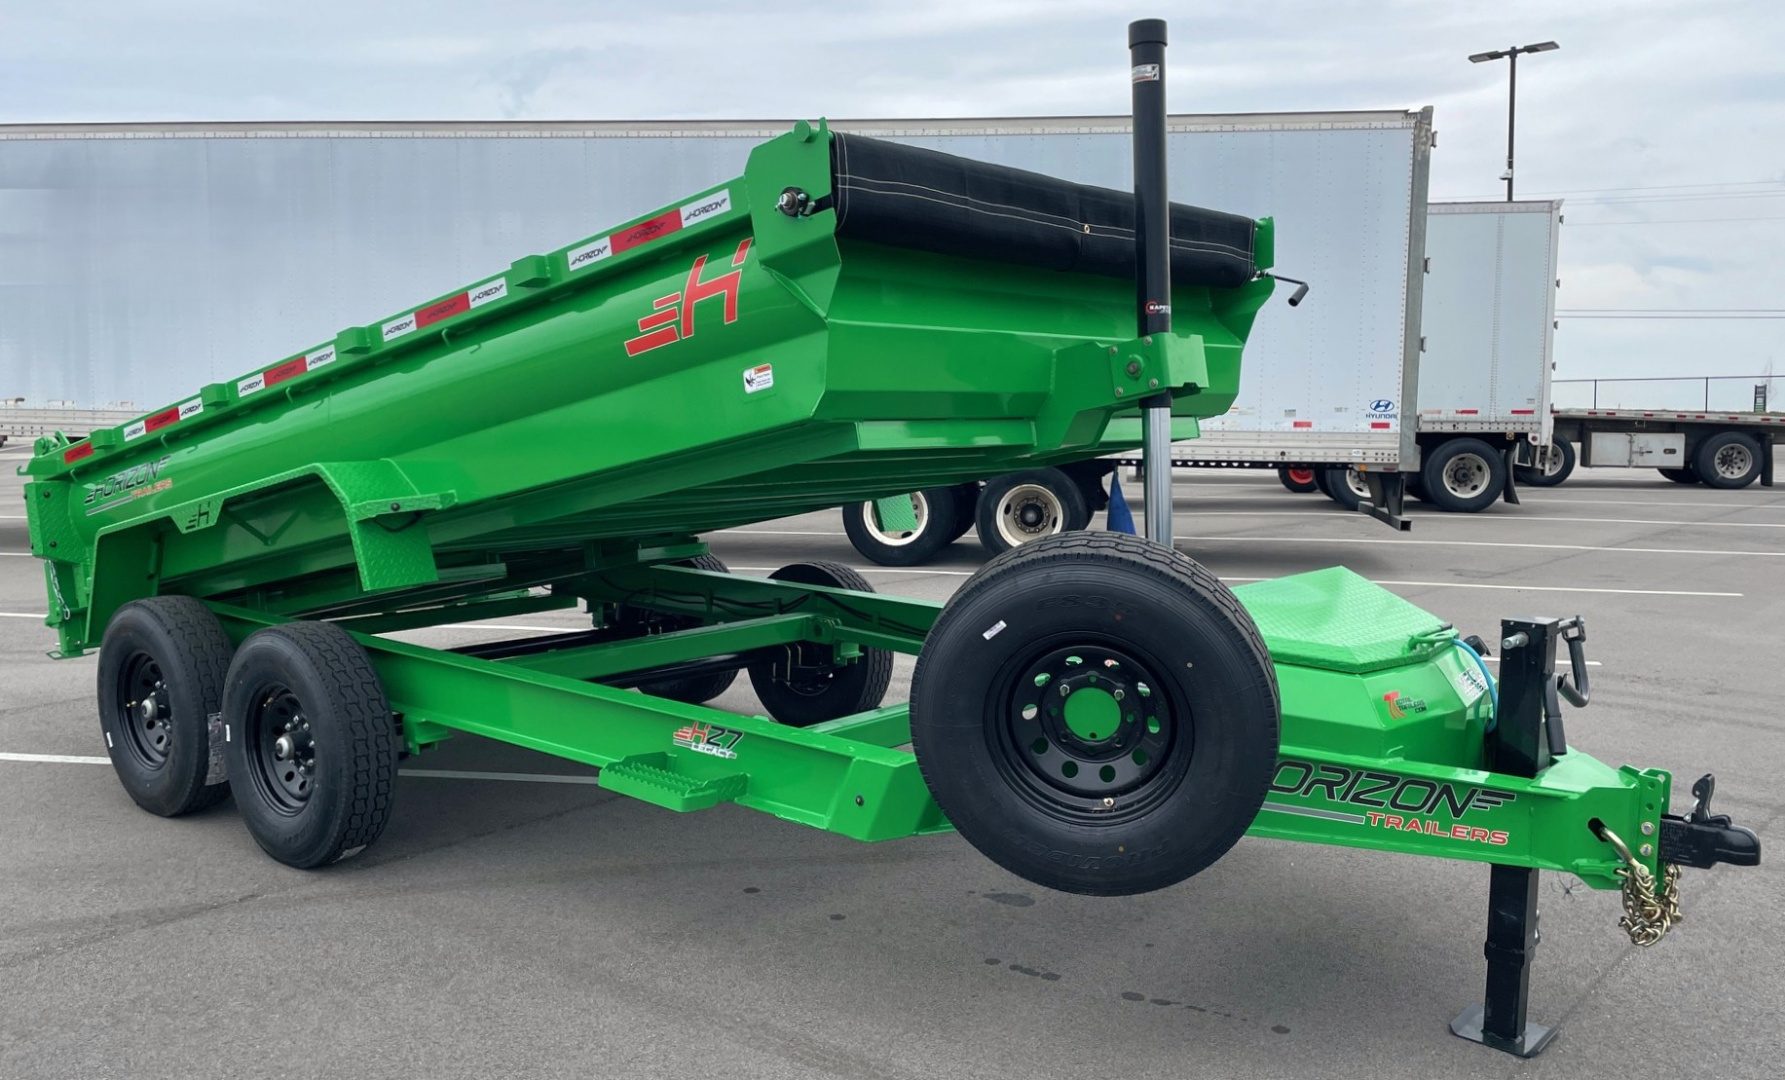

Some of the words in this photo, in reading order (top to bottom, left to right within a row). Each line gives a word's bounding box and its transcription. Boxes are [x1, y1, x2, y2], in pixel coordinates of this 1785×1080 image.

[685, 198, 727, 221] HORIZON
[571, 245, 608, 266] HORIZON
[85, 455, 170, 505] HORIZON
[1269, 760, 1479, 819] ORIZON
[1366, 811, 1510, 846] TRAILERS
